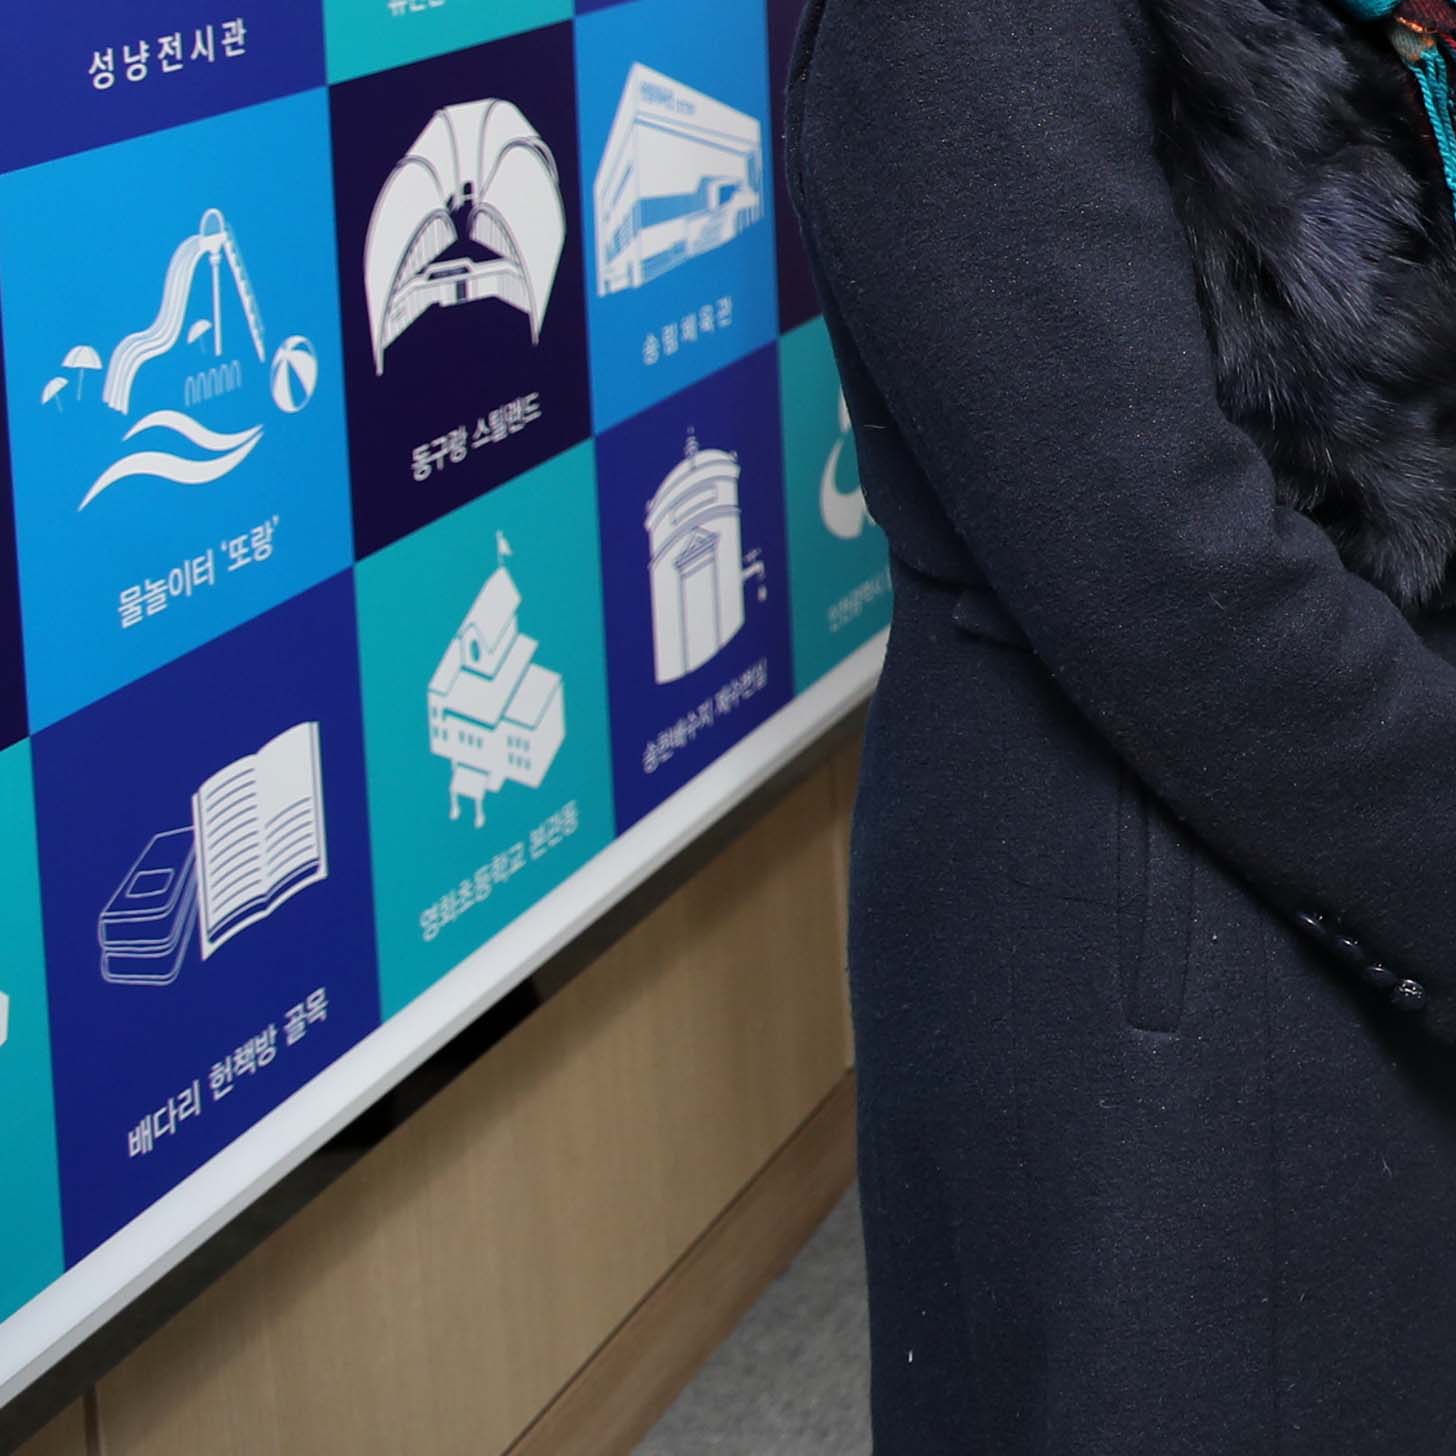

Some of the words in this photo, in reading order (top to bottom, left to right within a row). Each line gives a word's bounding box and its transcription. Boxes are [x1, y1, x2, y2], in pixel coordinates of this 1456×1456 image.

[88, 17, 247, 90] 성냥전시관
[411, 425, 468, 482] 동구랑
[471, 392, 542, 449] 스틸랜드
[117, 548, 215, 629] 물놀이터
[420, 842, 527, 942] 영화초등학교
[128, 1079, 201, 1158] 배다리
[209, 1023, 278, 1101] 헌책방
[284, 987, 329, 1047] 골목
